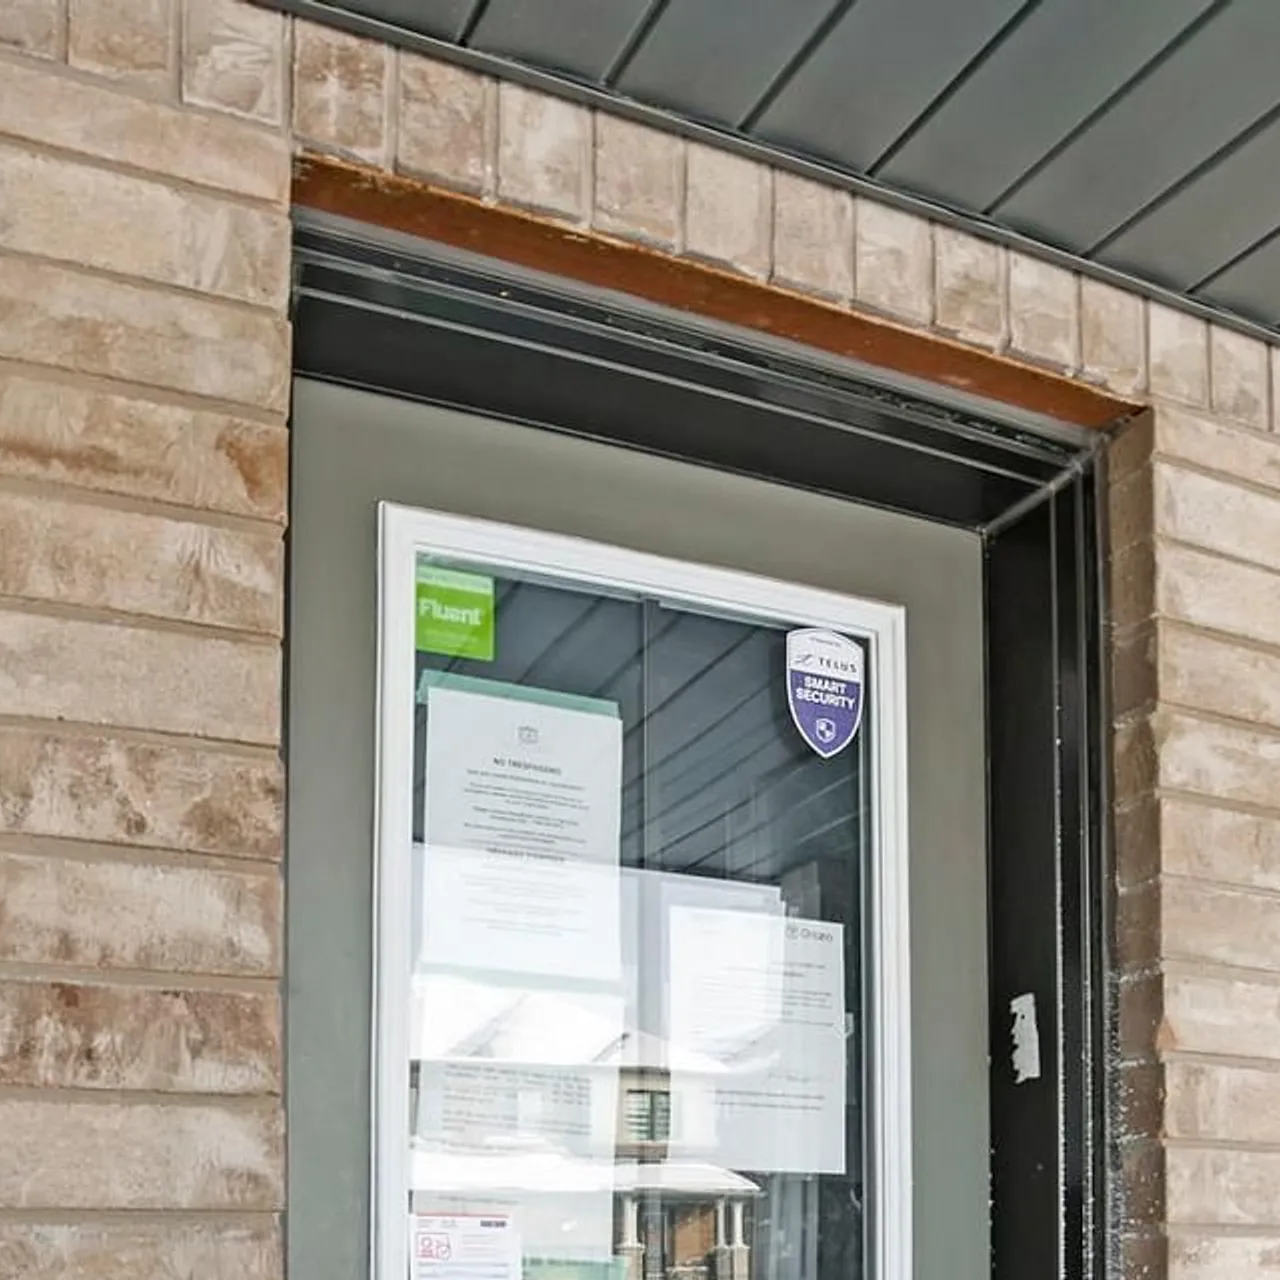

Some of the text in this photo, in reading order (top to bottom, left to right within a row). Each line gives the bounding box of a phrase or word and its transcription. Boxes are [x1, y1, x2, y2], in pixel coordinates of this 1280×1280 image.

[418, 597, 482, 626] Fluent
[819, 656, 857, 673] TELUS
[804, 675, 847, 694] SMART
[795, 687, 855, 710] SECURITY
